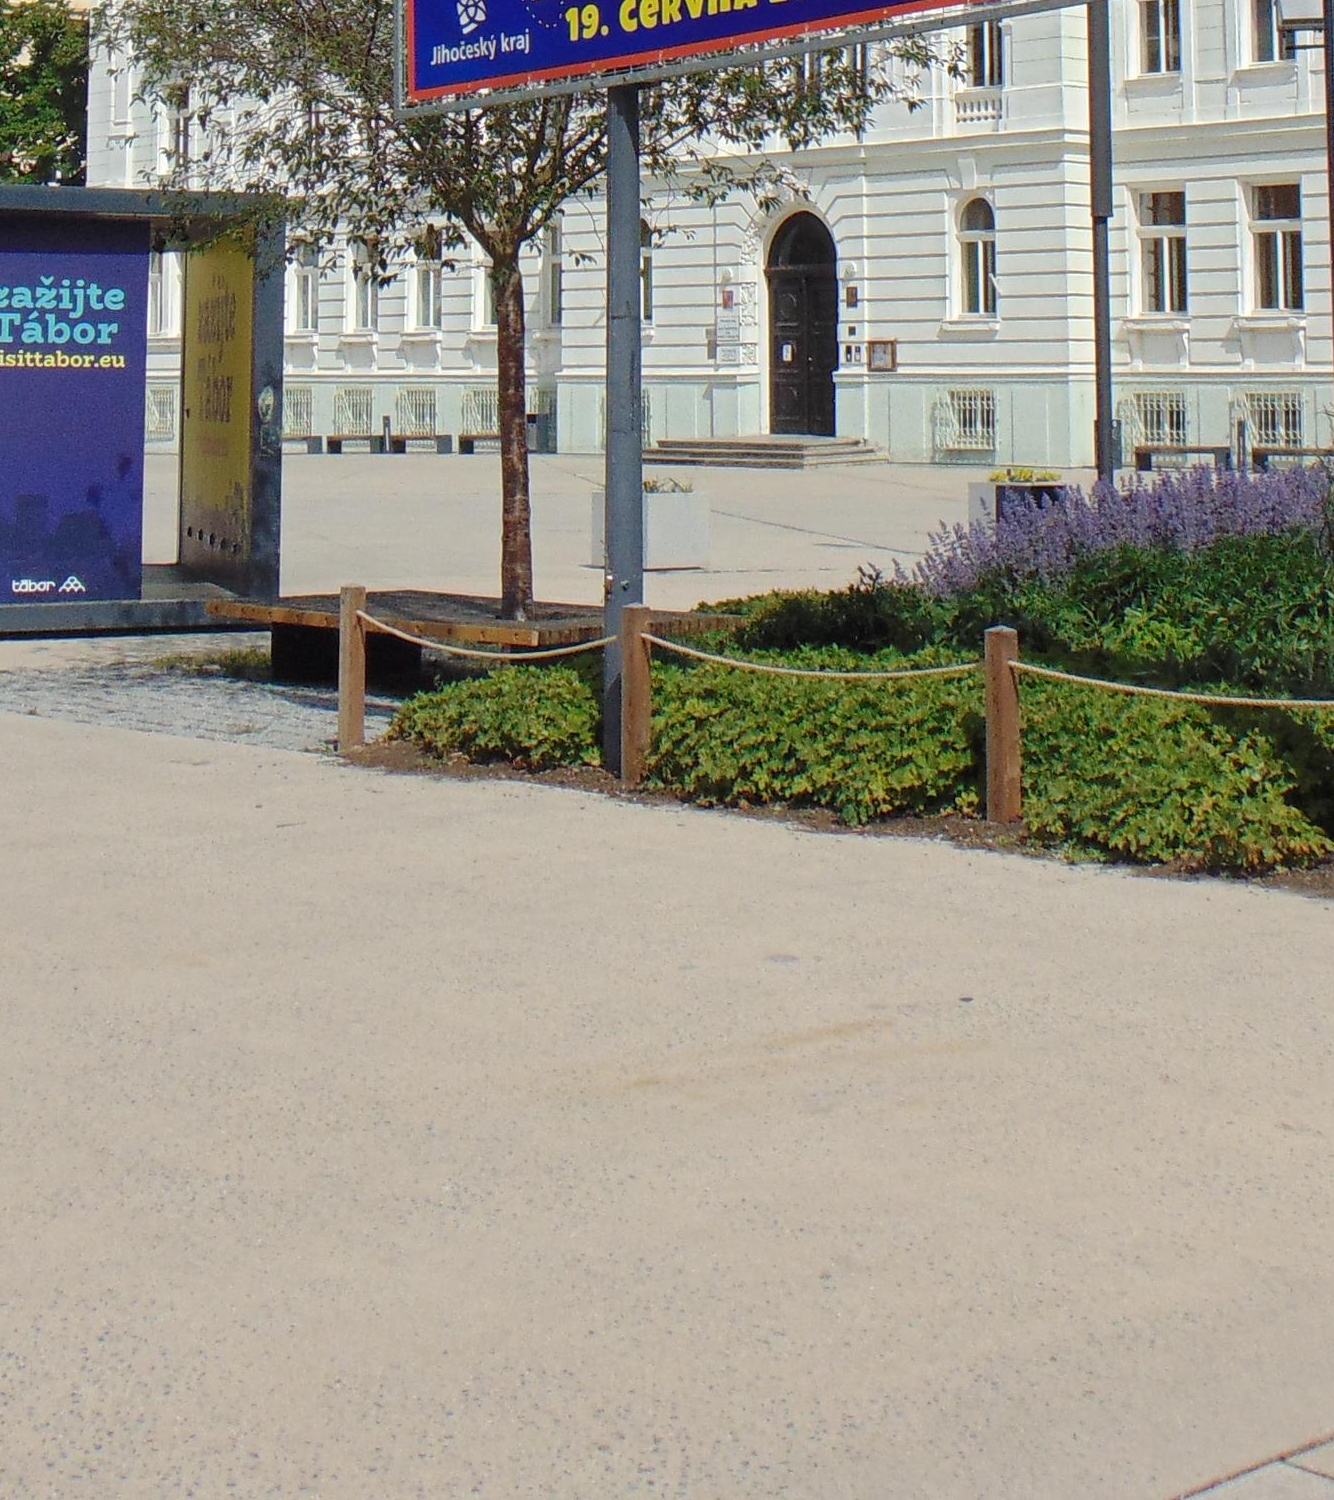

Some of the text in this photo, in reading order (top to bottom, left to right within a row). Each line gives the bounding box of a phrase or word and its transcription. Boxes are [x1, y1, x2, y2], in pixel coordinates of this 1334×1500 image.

[564, 4, 609, 41] 19.
[429, 27, 530, 66] Jihočeský kraj
